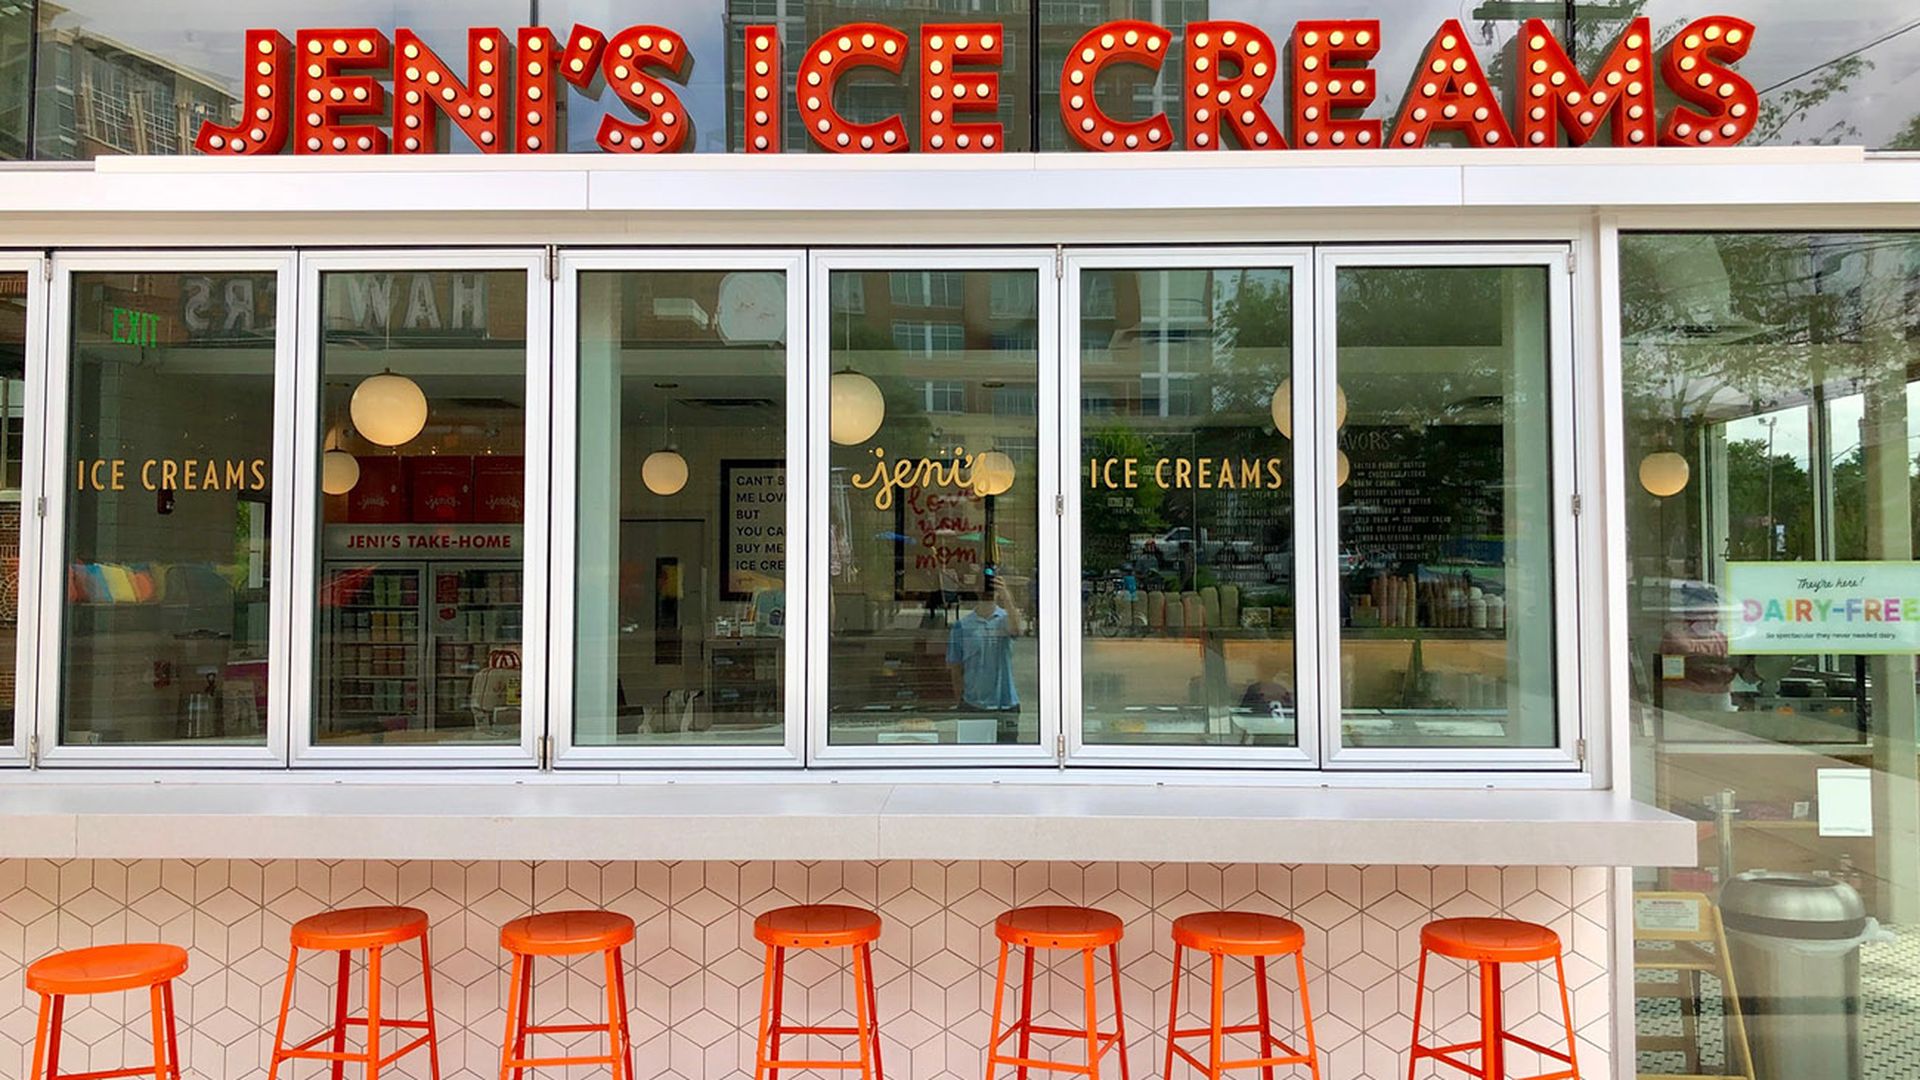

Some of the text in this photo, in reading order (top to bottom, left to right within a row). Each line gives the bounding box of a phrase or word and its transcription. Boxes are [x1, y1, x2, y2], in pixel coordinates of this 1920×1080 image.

[196, 16, 1759, 155] JENI'S ICE CREAMS
[112, 307, 160, 348] EXIT
[77, 459, 266, 491] ICE CREAMS
[852, 447, 989, 510] jeni's
[1090, 458, 1283, 489] ICE CREAMS
[736, 476, 774, 486] CAN'T
[736, 493, 755, 503] ME
[736, 510, 760, 520] BUT
[736, 527, 784, 537] YOU CA
[347, 534, 511, 548] JENI'S TAKE-HOME
[736, 544, 784, 553] BUY ME
[916, 547, 976, 569] mom
[736, 561, 785, 571] ICE CRE
[1835, 576, 1864, 588] here!
[1743, 598, 1920, 622] DAIRY-FREE
